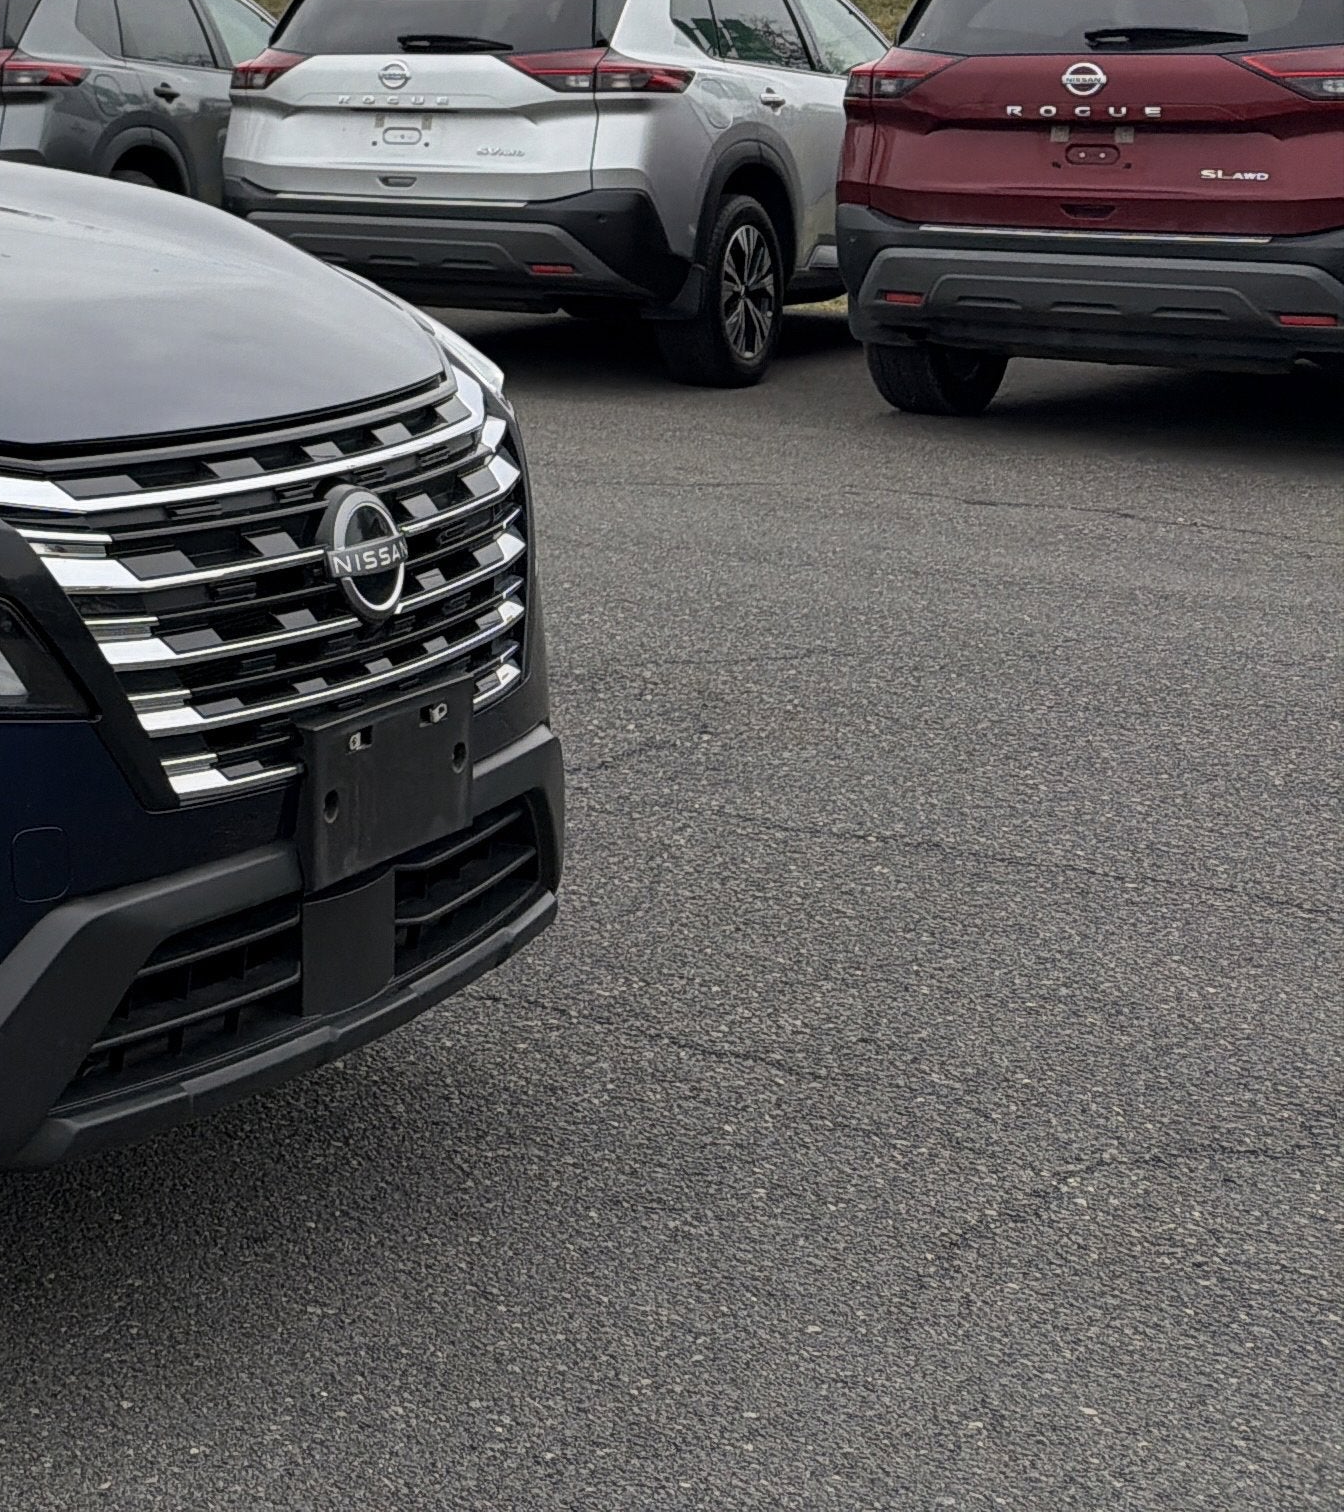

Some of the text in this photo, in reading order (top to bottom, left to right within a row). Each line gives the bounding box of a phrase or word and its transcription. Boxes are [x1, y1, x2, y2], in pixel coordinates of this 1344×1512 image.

[338, 94, 450, 106] ROGUE
[1005, 104, 1162, 118] ROGUE
[332, 539, 409, 574] NISSAN
